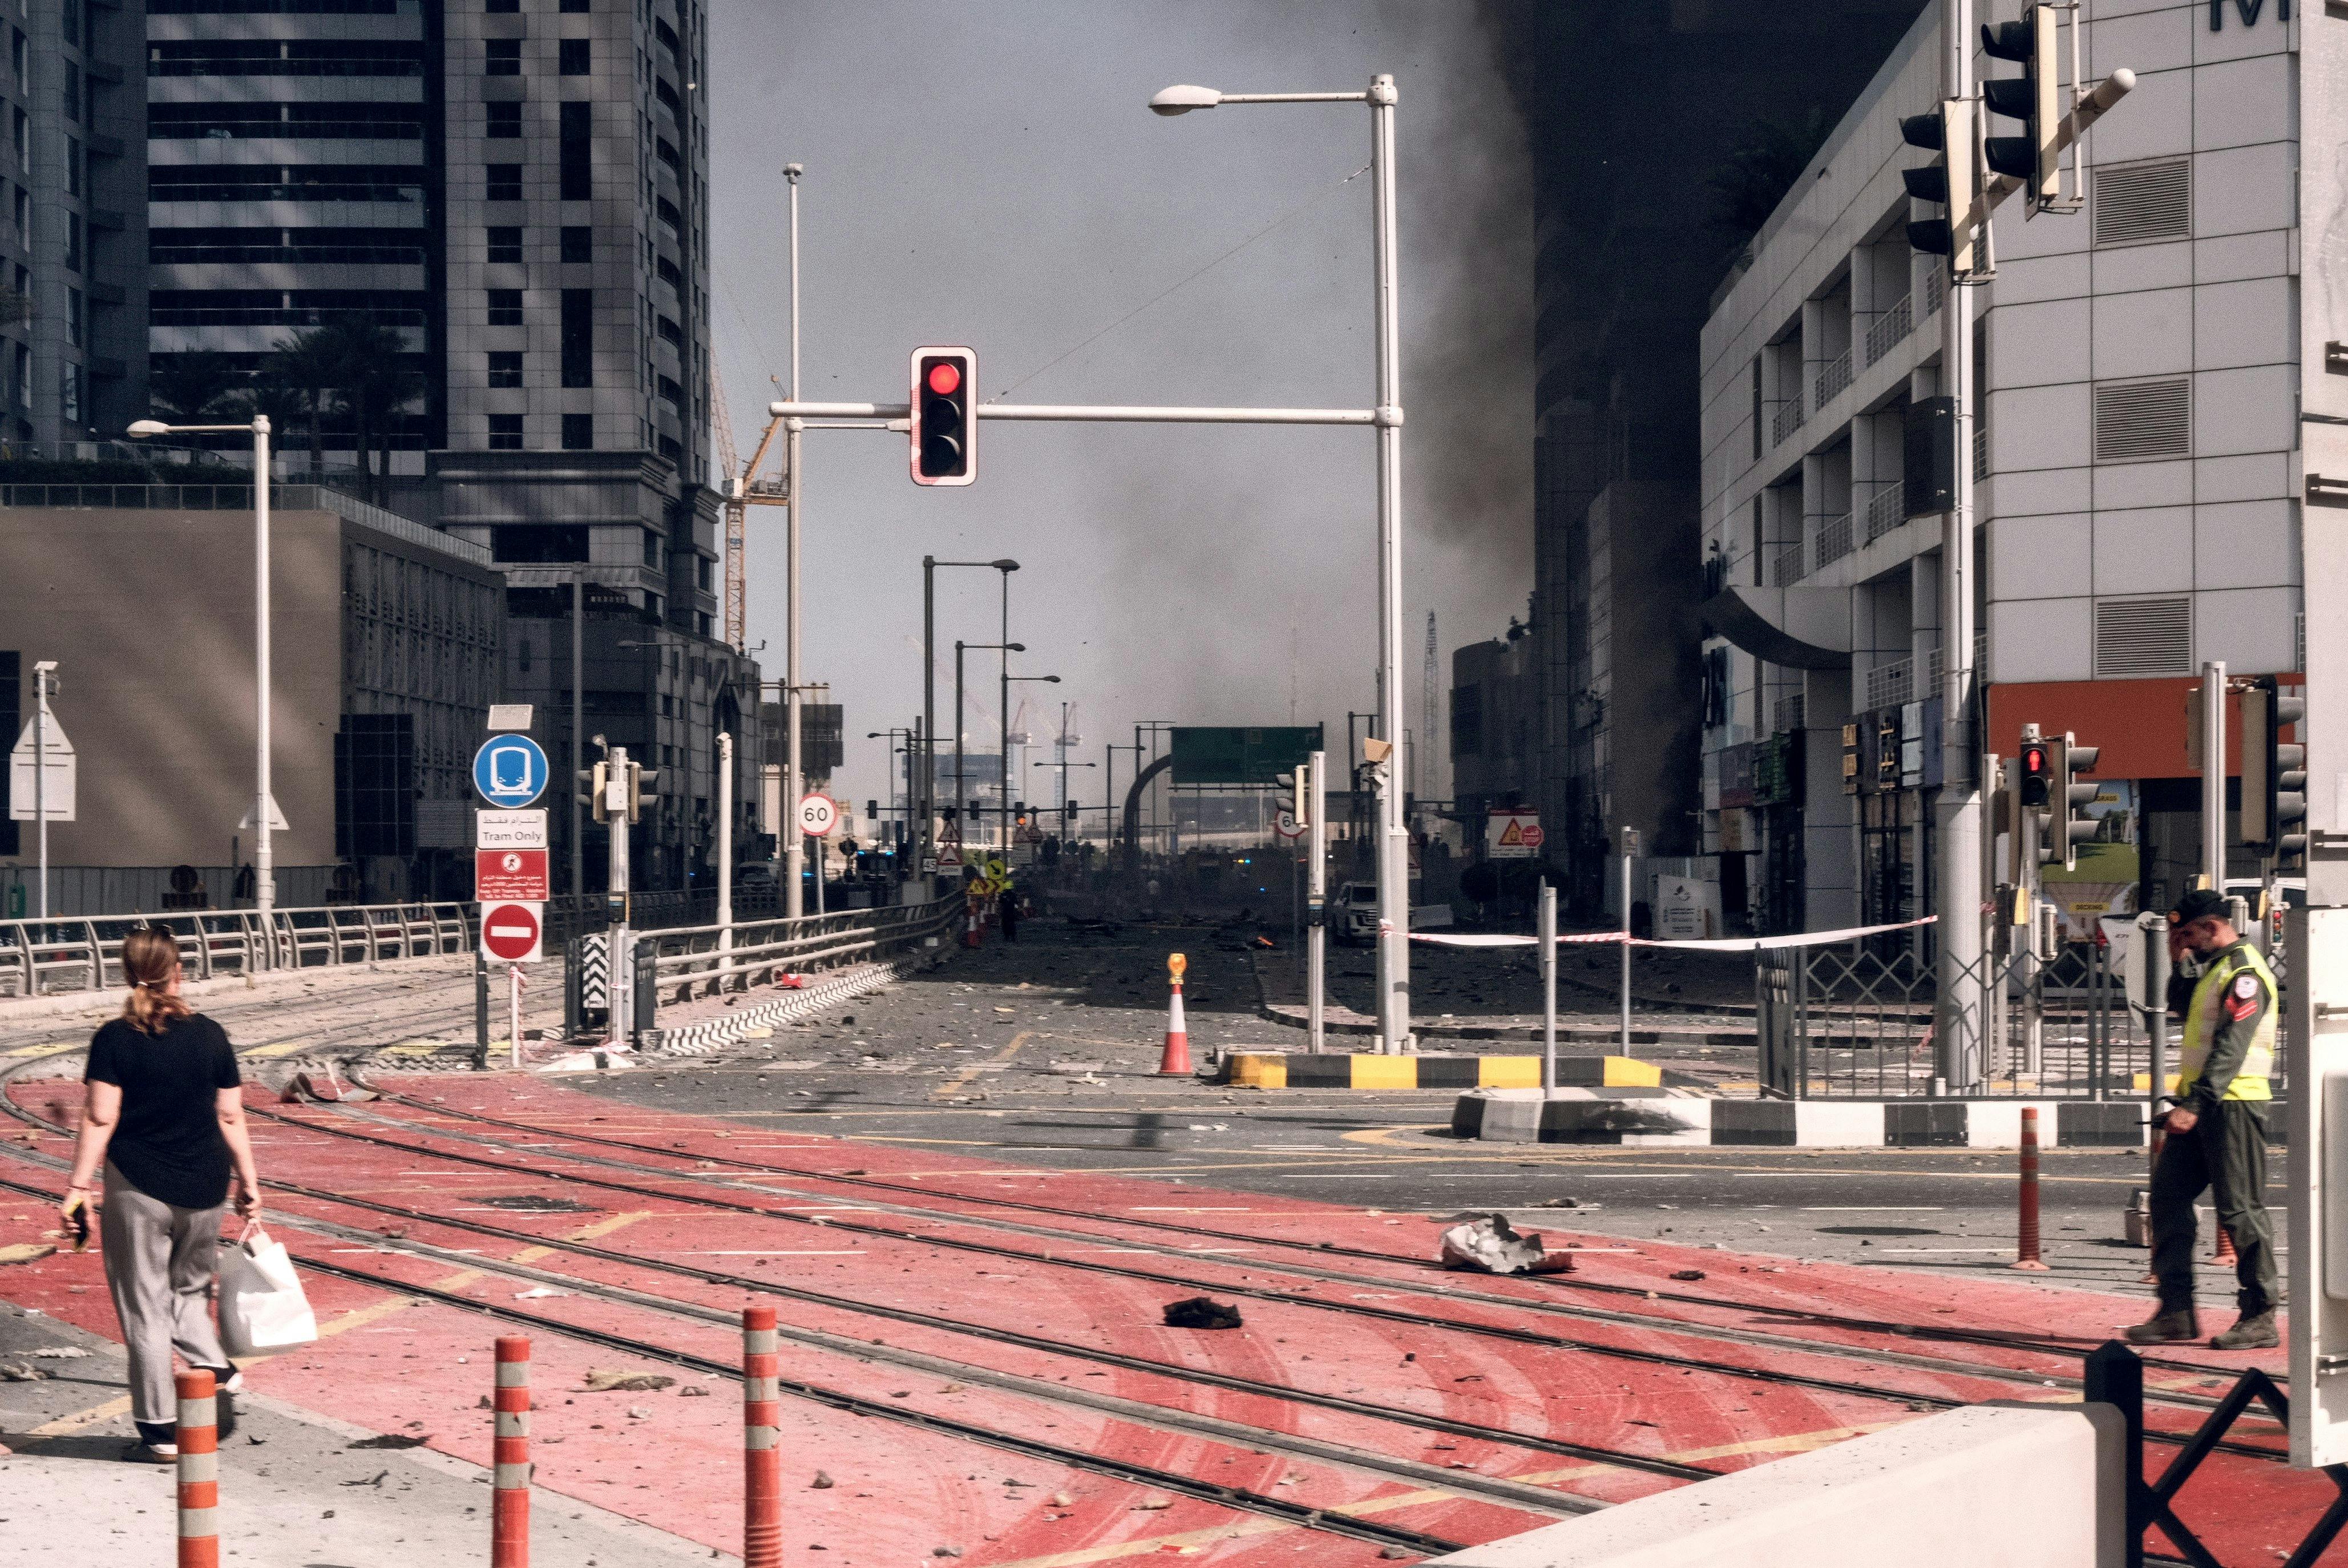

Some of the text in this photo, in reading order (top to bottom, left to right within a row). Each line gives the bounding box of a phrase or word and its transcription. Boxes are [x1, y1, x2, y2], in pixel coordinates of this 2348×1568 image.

[805, 807, 827, 821] 60
[1282, 816, 1290, 827] 6
[483, 831, 542, 842] Tram Only
